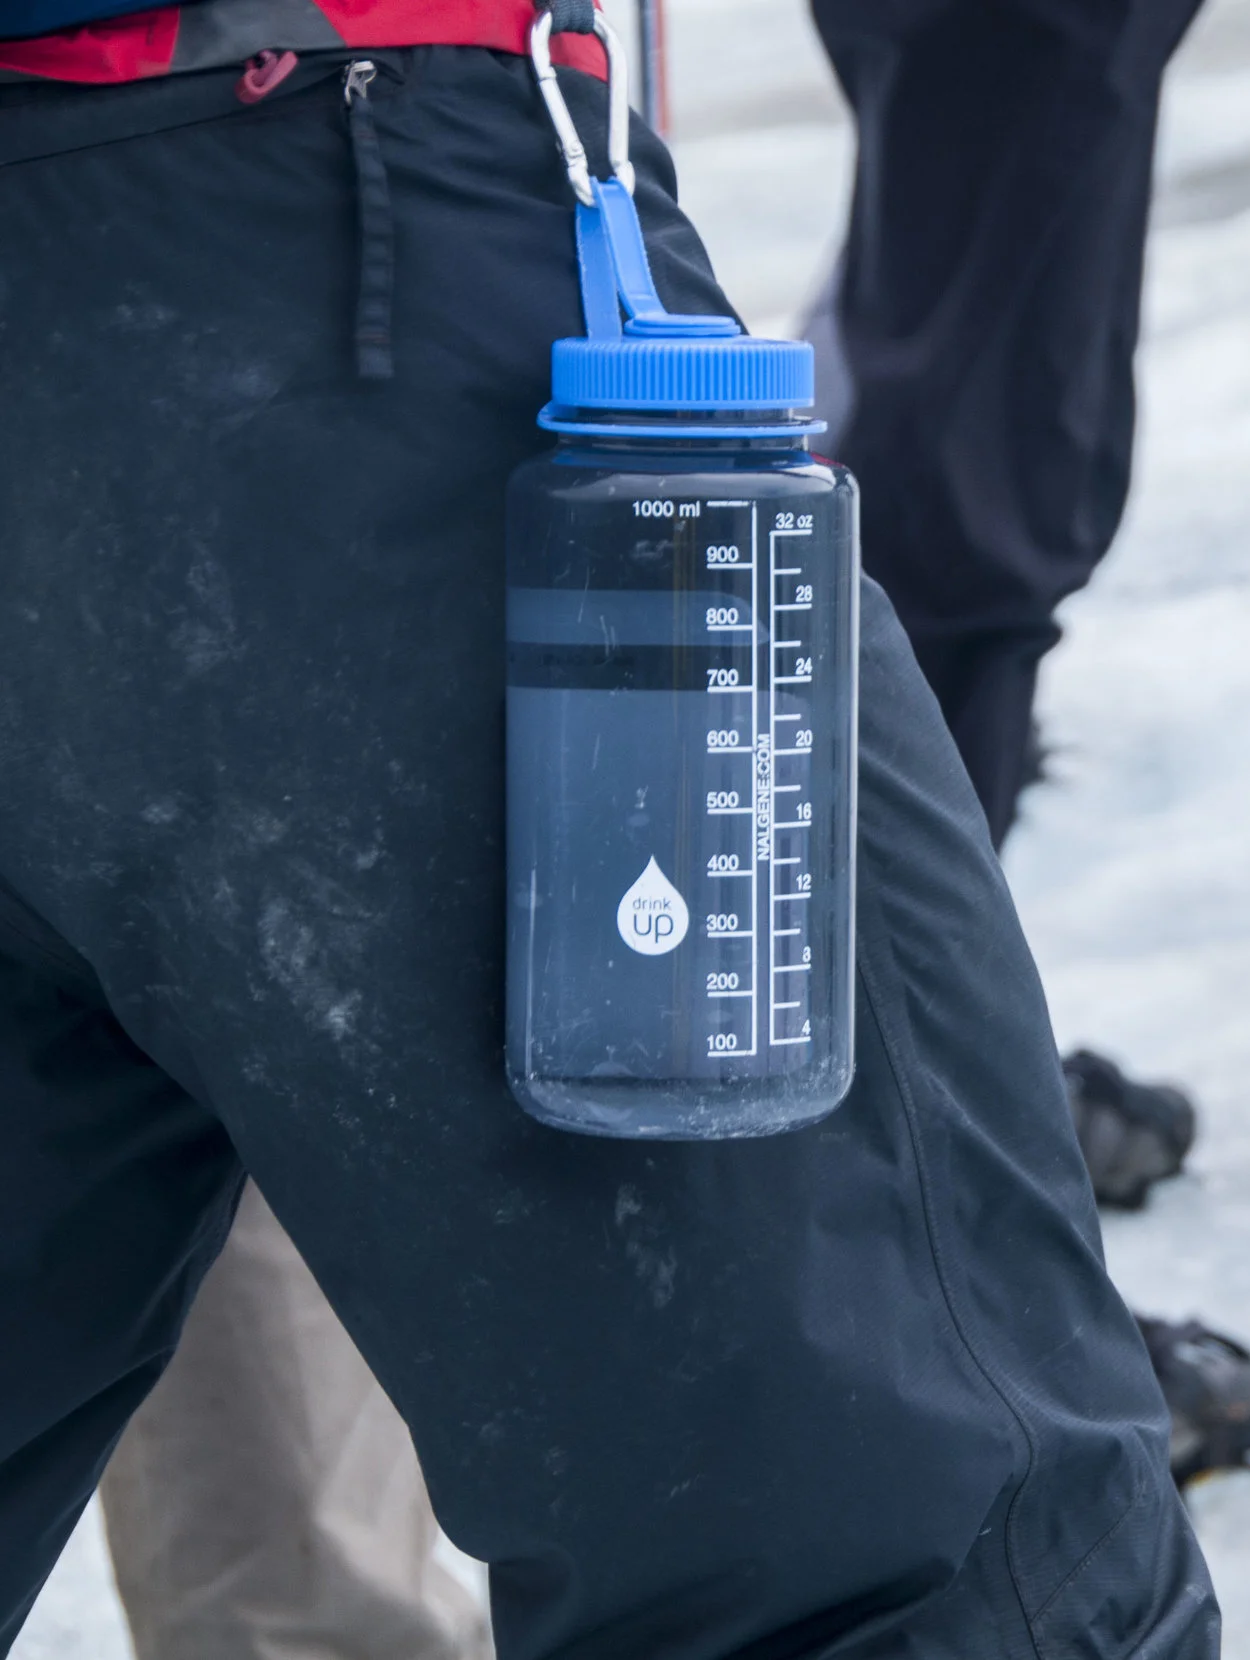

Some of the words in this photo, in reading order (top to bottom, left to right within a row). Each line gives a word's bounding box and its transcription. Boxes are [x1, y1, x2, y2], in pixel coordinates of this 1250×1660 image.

[633, 501, 674, 517] 1000
[680, 501, 700, 517] ml
[776, 513, 794, 528] 32
[797, 514, 813, 528] oz
[707, 546, 738, 562] 900
[796, 585, 812, 601] 28
[706, 608, 738, 624] 800
[796, 658, 812, 674] 24
[707, 669, 738, 685] 700
[707, 730, 738, 746] 600
[796, 730, 812, 746] 20
[707, 792, 738, 807] 500
[757, 733, 770, 861] NALGENE.COM
[796, 803, 811, 819] 16
[707, 855, 739, 871] 400
[796, 874, 811, 890] 12
[633, 897, 672, 910] drink
[707, 914, 738, 930] 300
[707, 973, 738, 989] 200
[802, 1019, 811, 1034] 4
[707, 1034, 736, 1049] 100
